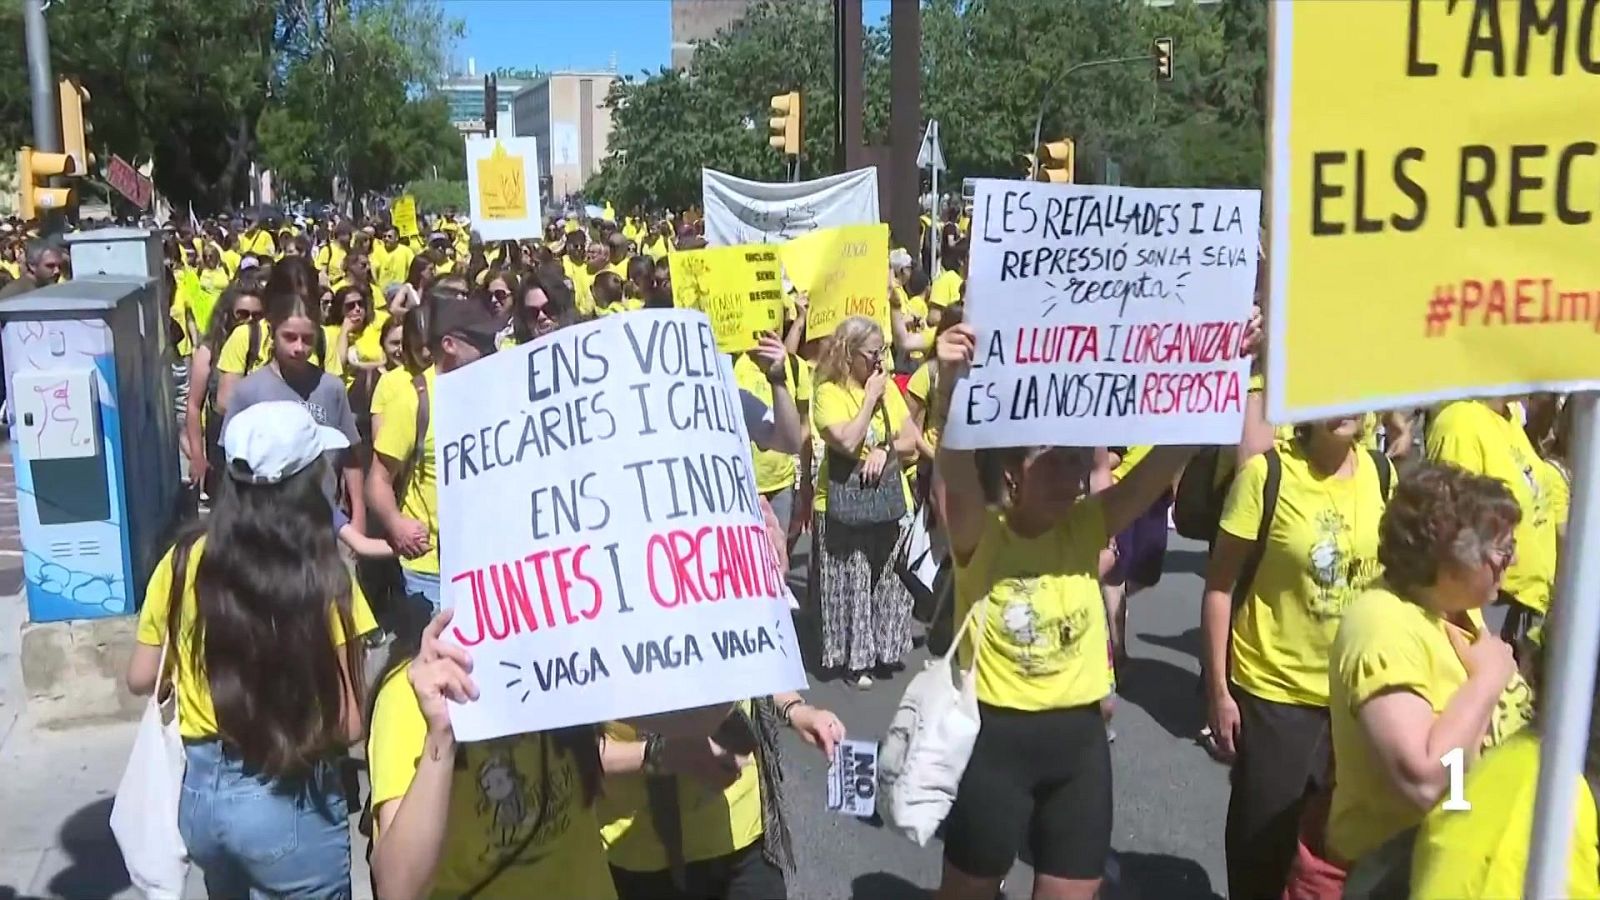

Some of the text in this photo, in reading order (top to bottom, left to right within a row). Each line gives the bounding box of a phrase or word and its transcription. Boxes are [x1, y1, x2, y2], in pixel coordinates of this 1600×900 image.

[984, 191, 1243, 243] LES RETALLADES I LA
[1310, 142, 1598, 237] ELS REC
[1000, 241, 1128, 282] REPRESSIÓ
[1200, 246, 1248, 267] SEVA
[1063, 272, 1172, 317] recepta
[528, 329, 609, 402] ENS
[972, 329, 1005, 369] A
[1015, 325, 1099, 364] LLUITA
[1102, 324, 1122, 362] I
[1010, 373, 1039, 421] LA
[1043, 372, 1137, 419] NOSTRA
[1139, 371, 1241, 414] RESPOSTA
[443, 381, 741, 487] PRECÀRIES I CALL
[531, 453, 761, 540] ENS TINDR
[451, 544, 602, 647] JUNTES
[604, 543, 634, 613] I
[533, 625, 776, 692] VAGA VAGA VAGA
[854, 752, 875, 800] NO
